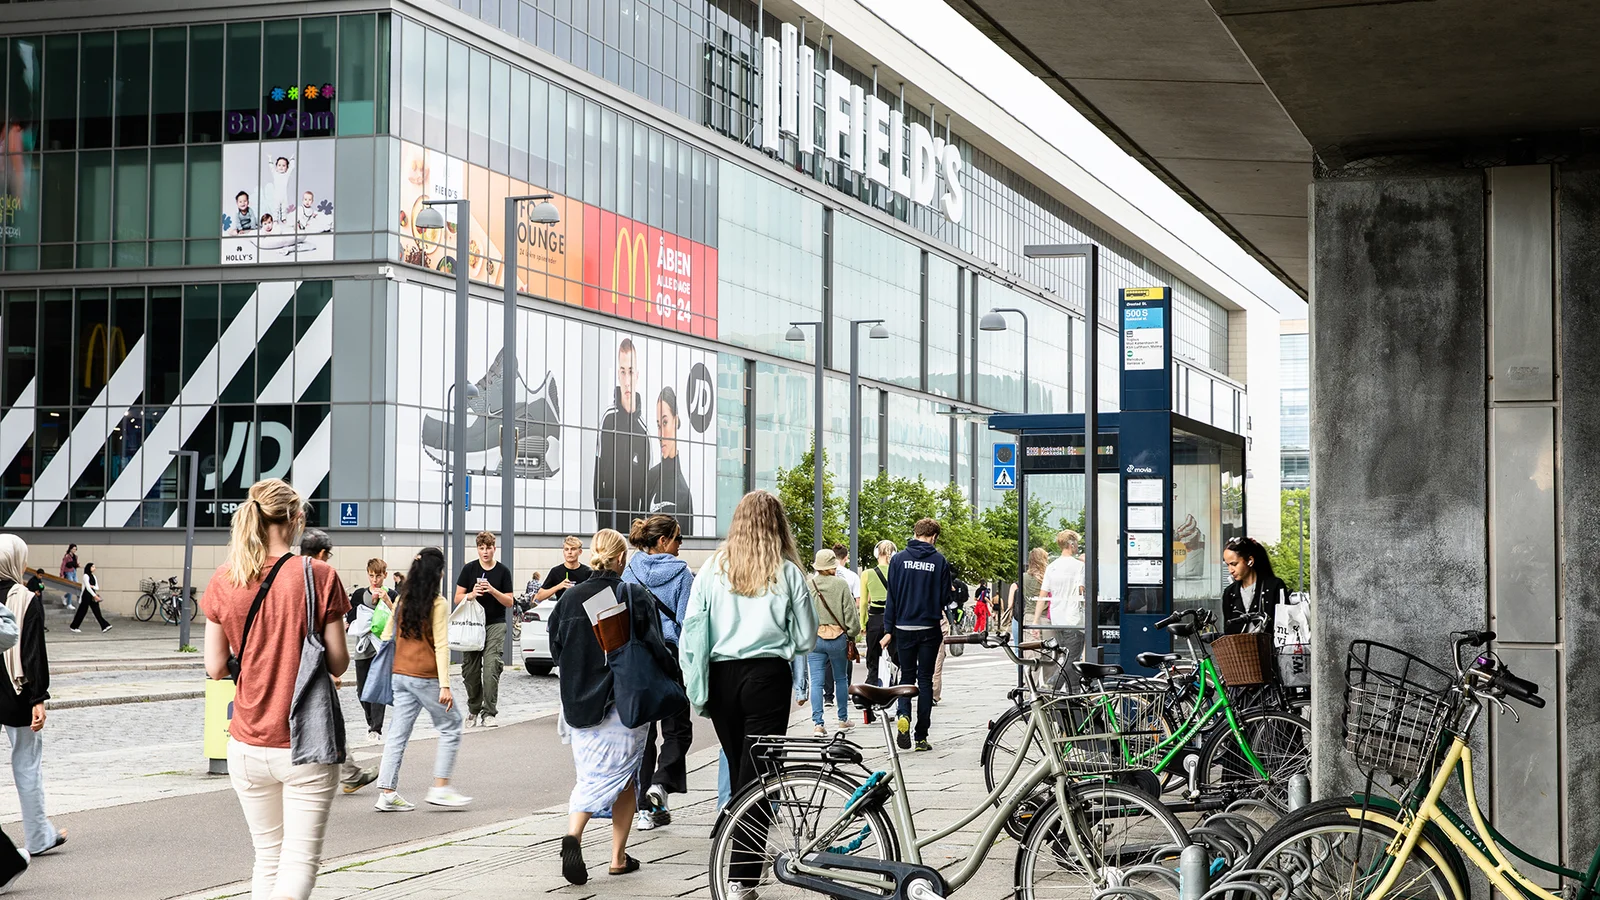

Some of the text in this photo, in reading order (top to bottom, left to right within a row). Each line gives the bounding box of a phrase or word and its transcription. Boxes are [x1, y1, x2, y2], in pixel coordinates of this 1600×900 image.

[228, 109, 335, 137] BabySam
[825, 69, 963, 223] FIELD'S
[517, 222, 564, 254] OUNGE
[656, 236, 691, 277] ÅBEN
[656, 292, 692, 323] 09-24
[690, 378, 711, 416] JD
[204, 421, 292, 490] JD
[903, 560, 935, 572] TRÆNER
[1459, 823, 1487, 853] ROYAL
